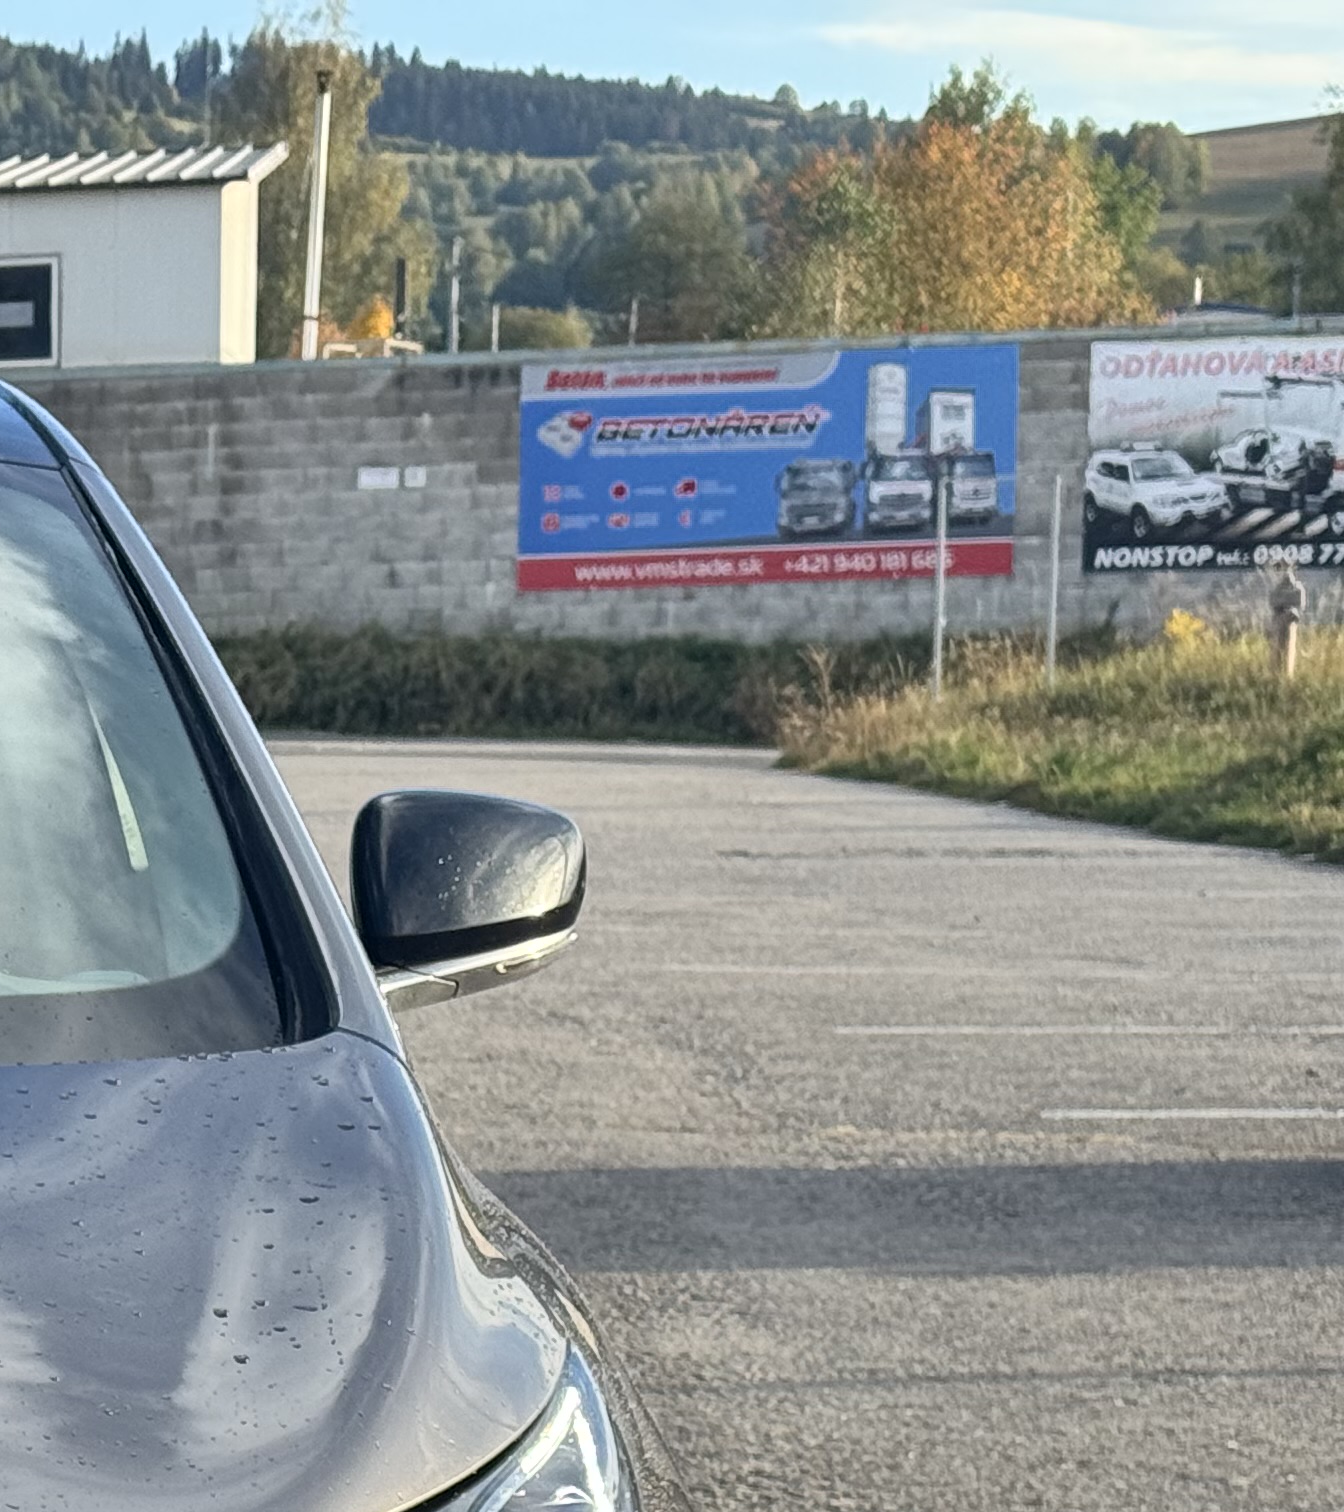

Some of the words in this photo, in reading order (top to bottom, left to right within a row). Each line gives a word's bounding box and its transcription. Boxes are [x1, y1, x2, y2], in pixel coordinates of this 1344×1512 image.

[596, 404, 824, 442] BETONÁREŇ
[574, 556, 765, 582] www.vmstrade.sk
[784, 553, 831, 574] +421
[1094, 545, 1214, 568] NONSTOP
[1254, 544, 1313, 566] 0908
